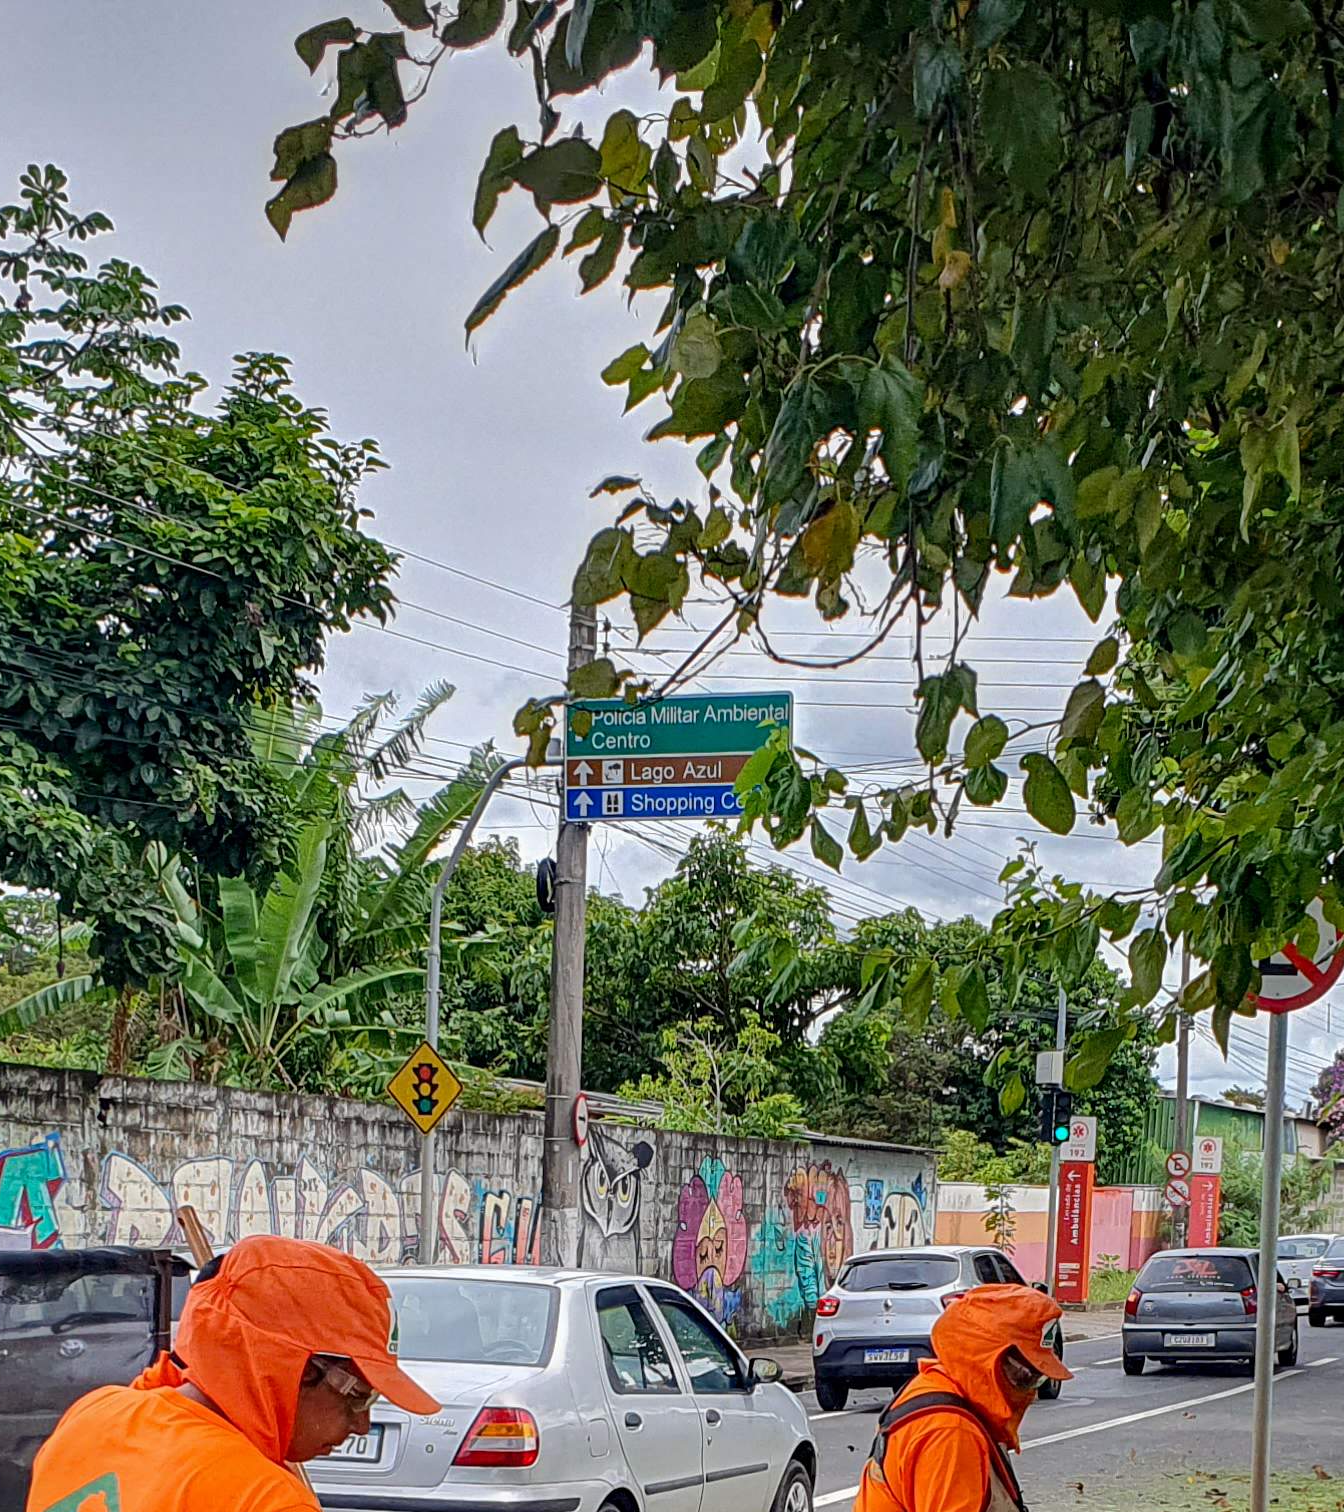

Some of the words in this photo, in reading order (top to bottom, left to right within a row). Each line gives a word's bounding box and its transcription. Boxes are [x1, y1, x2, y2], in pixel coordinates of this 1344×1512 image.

[650, 705, 699, 725] Militar
[704, 703, 789, 723] Ambiental
[591, 731, 651, 750] Centro
[631, 763, 675, 784] Lago
[683, 761, 722, 779] Azul
[631, 793, 716, 816] Shopping
